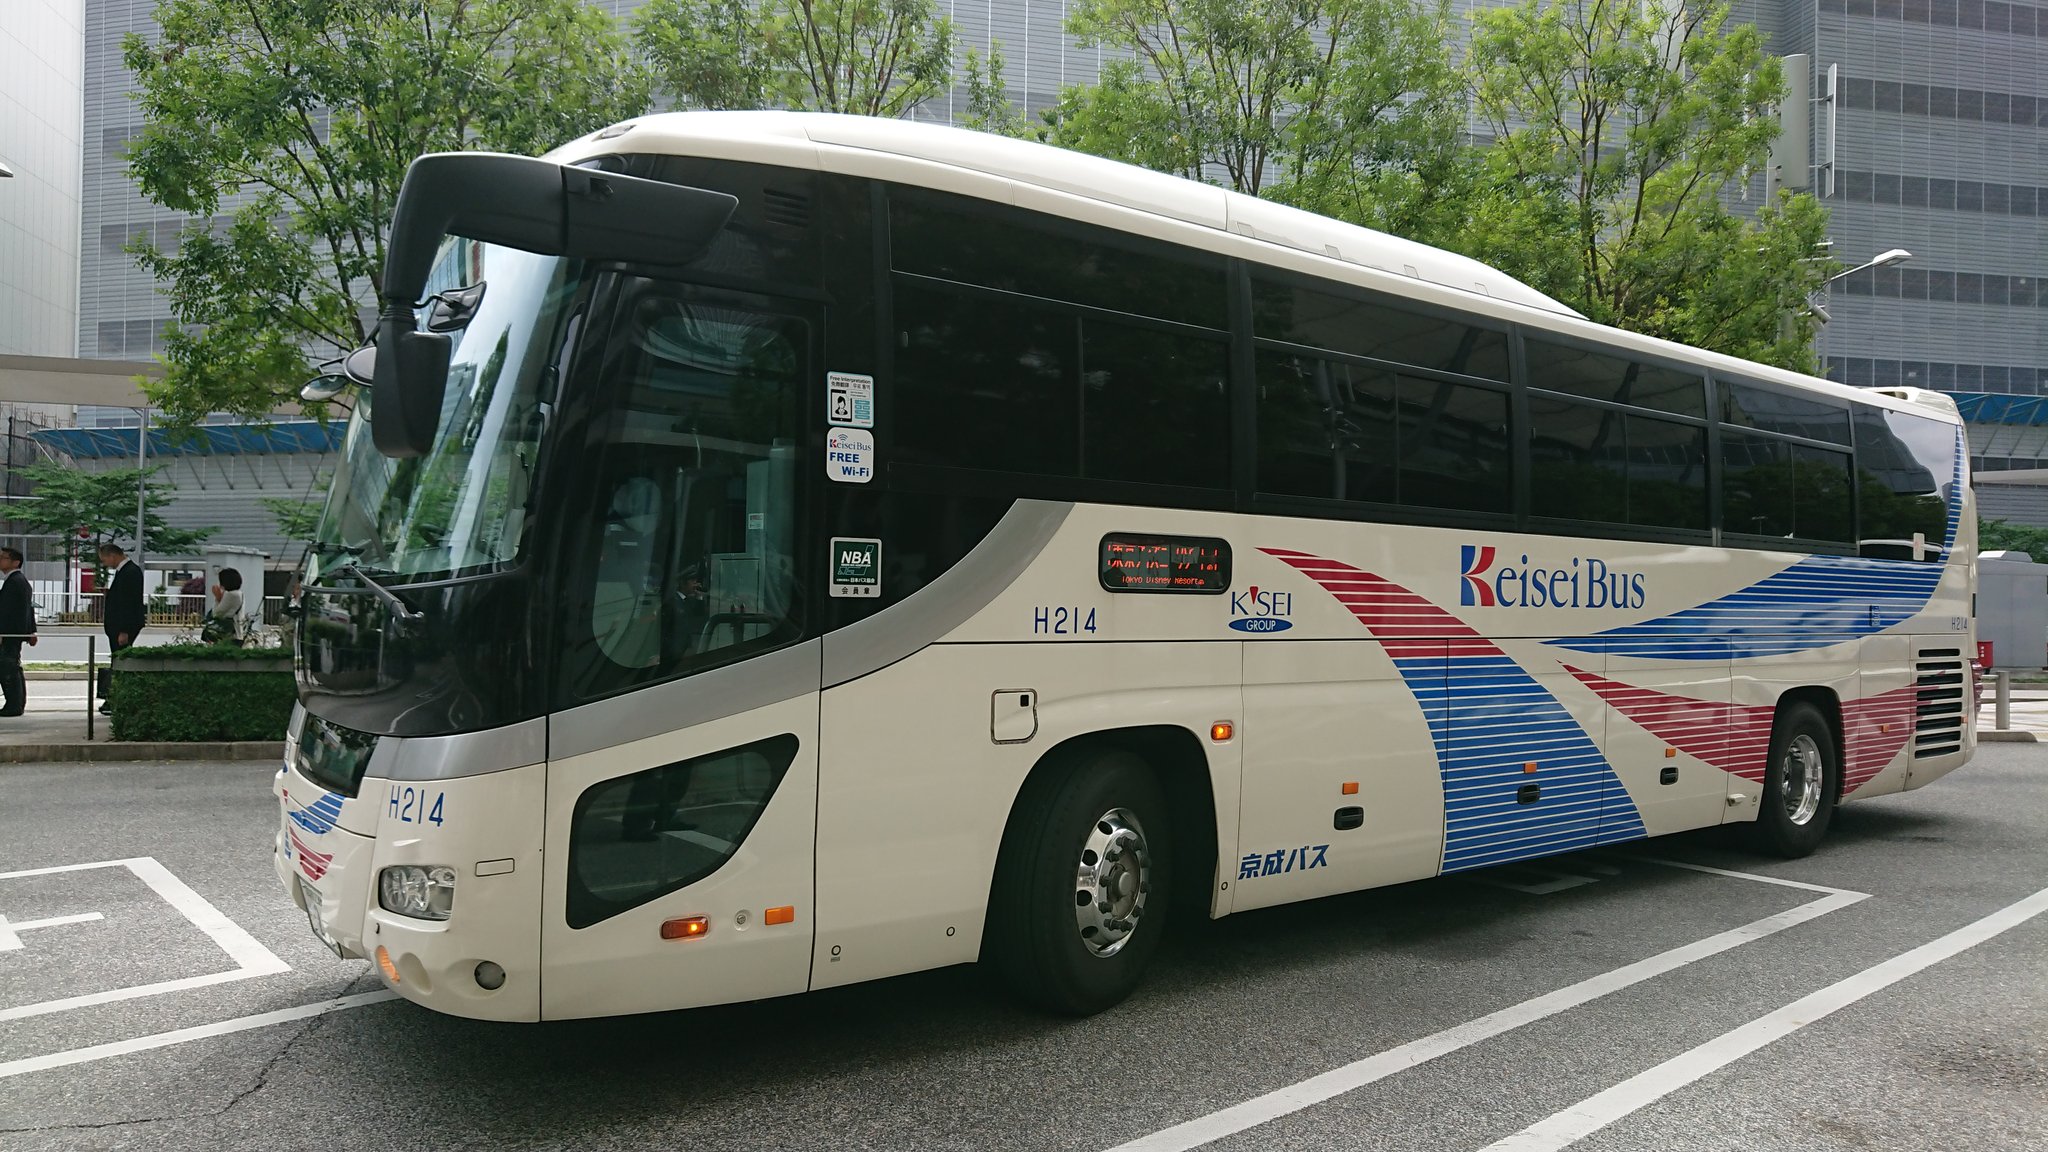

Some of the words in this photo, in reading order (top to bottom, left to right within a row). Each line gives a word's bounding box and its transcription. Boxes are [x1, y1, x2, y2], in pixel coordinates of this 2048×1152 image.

[829, 452, 860, 463] FREE
[841, 466, 870, 477] Wi-Fi
[841, 550, 871, 565] NBA
[1034, 606, 1097, 634] H214
[1246, 620, 1276, 631] GROUP
[1951, 616, 1968, 630] H214
[388, 785, 444, 827] H214
[1238, 844, 1330, 880] 京成バス
